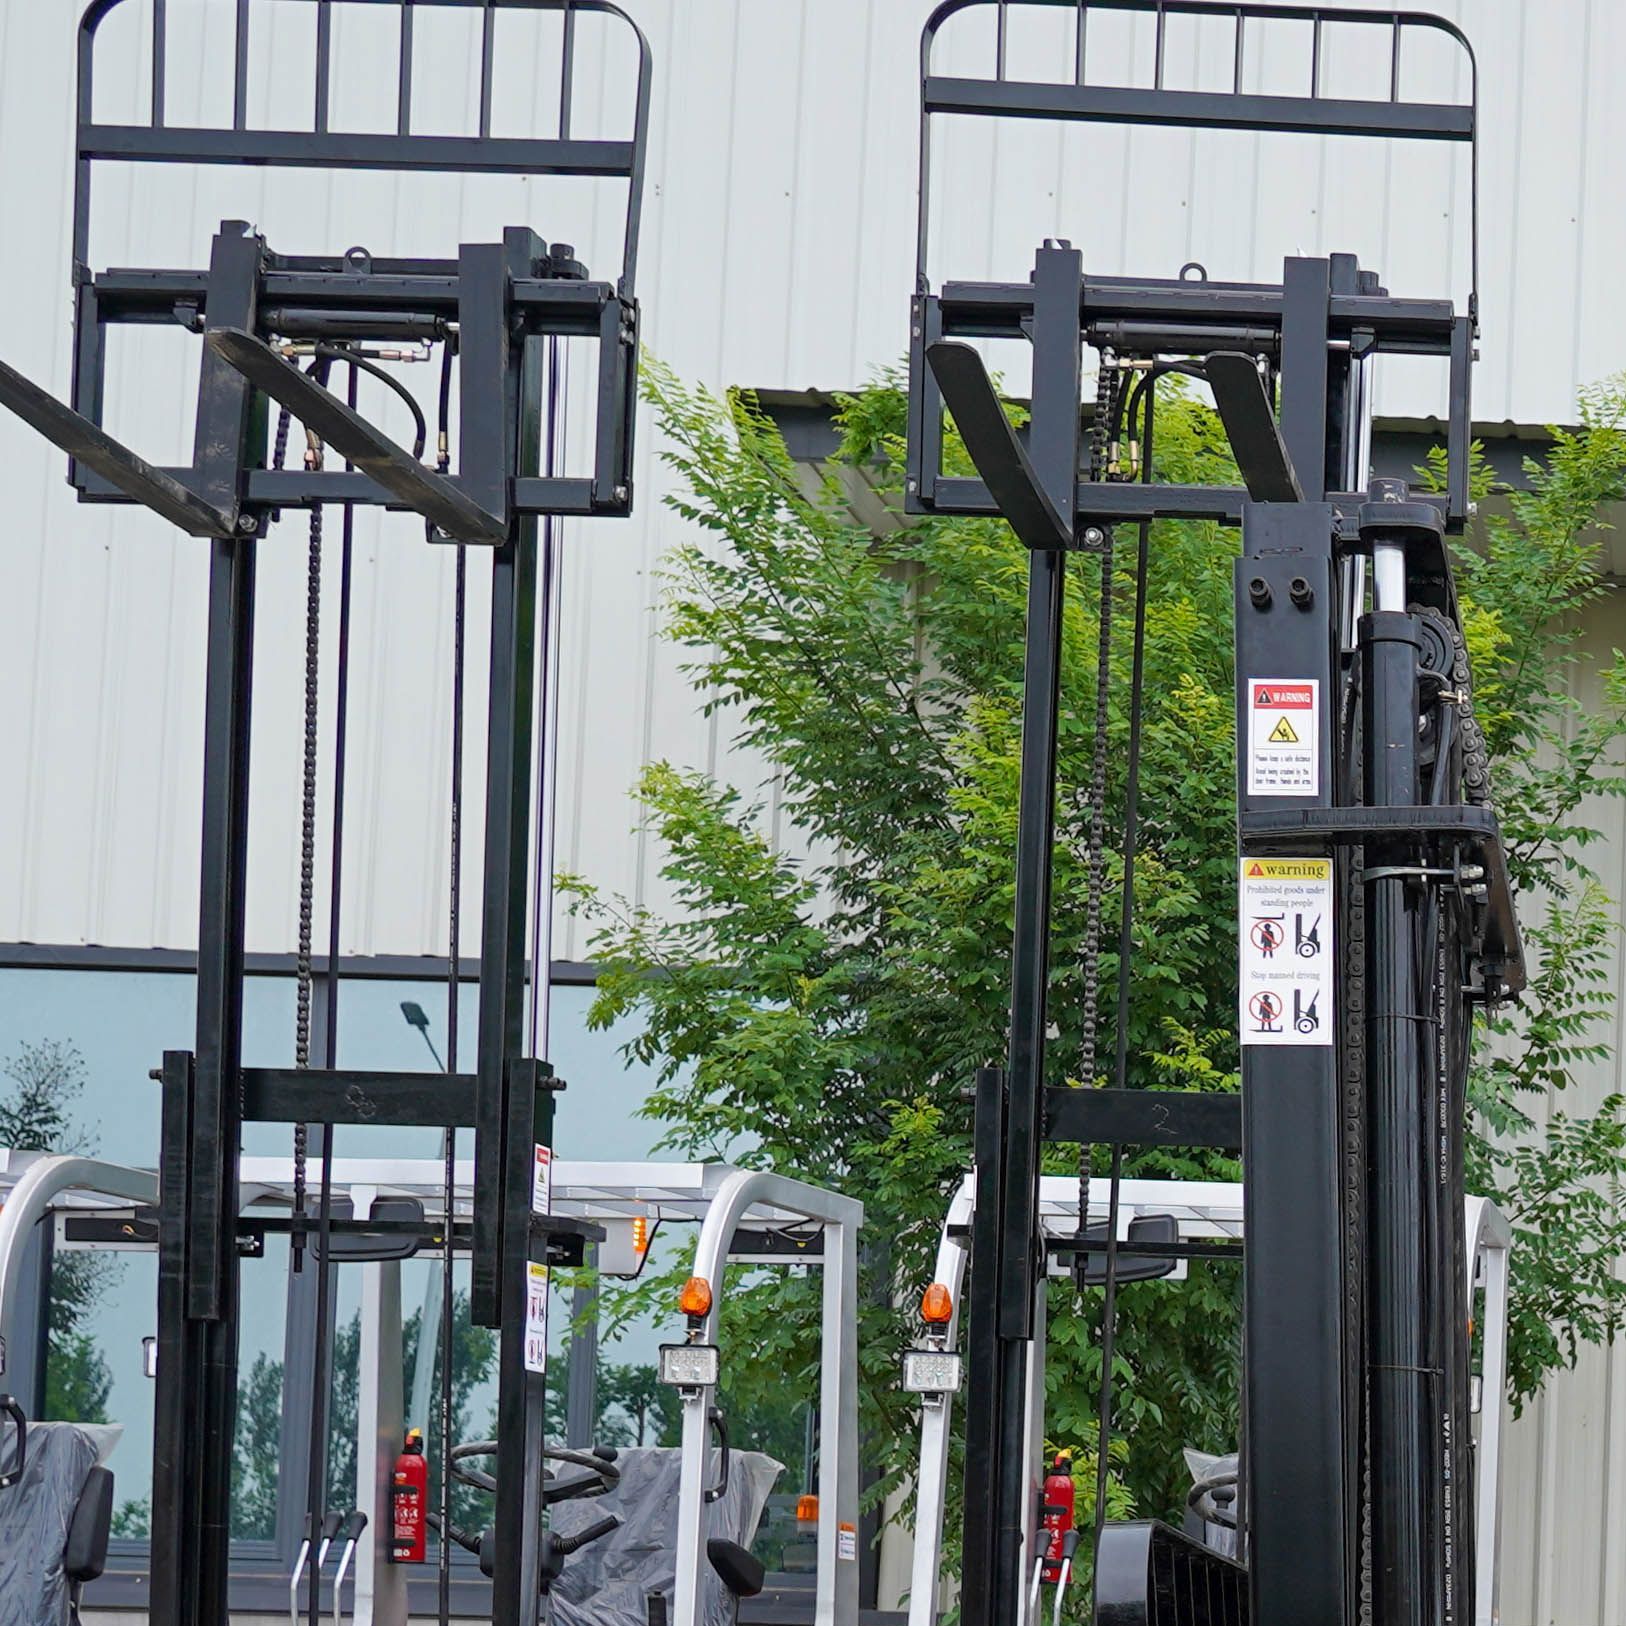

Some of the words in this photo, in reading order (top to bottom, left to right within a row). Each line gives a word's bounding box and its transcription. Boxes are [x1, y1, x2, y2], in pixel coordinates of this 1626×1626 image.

[1273, 692, 1311, 703] WARNING
[1266, 864, 1324, 878] warning
[1247, 886, 1282, 894] Prohibited
[1284, 886, 1304, 895] goods
[1306, 886, 1325, 894] under
[1261, 899, 1289, 908] standing
[1291, 899, 1313, 908] people
